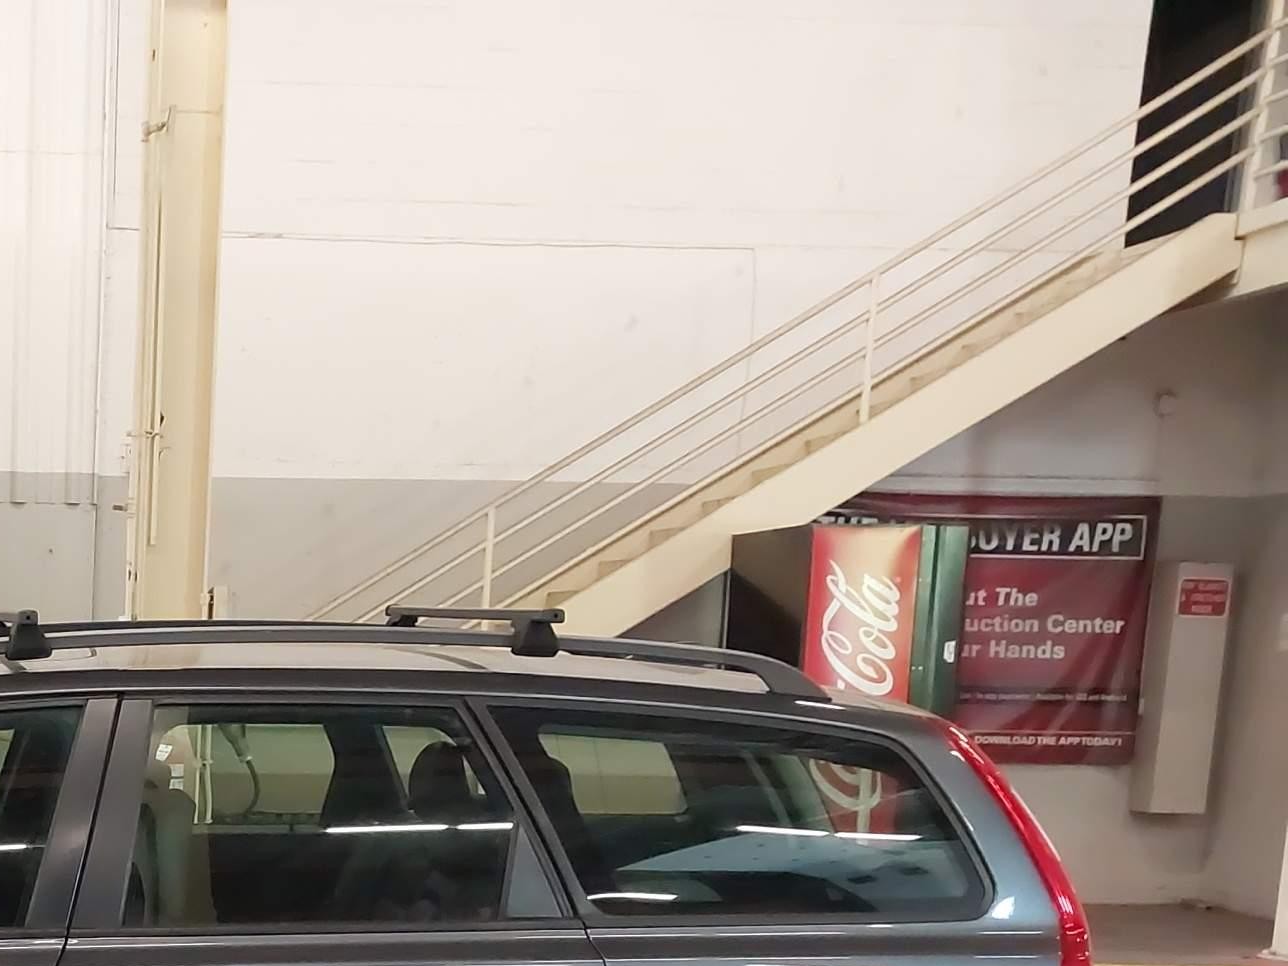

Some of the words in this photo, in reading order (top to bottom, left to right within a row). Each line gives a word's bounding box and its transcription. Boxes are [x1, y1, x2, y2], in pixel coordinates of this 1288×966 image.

[970, 522, 1061, 552] UYER
[1068, 522, 1134, 553] APP
[995, 587, 1038, 606] The
[821, 559, 901, 696] Cola
[964, 615, 1039, 633] uction
[1047, 614, 1125, 634] Center
[989, 640, 1065, 659] Hands
[974, 735, 1035, 745] DOWNLOAD
[1037, 735, 1057, 746] THE
[1058, 736, 1081, 746] APP
